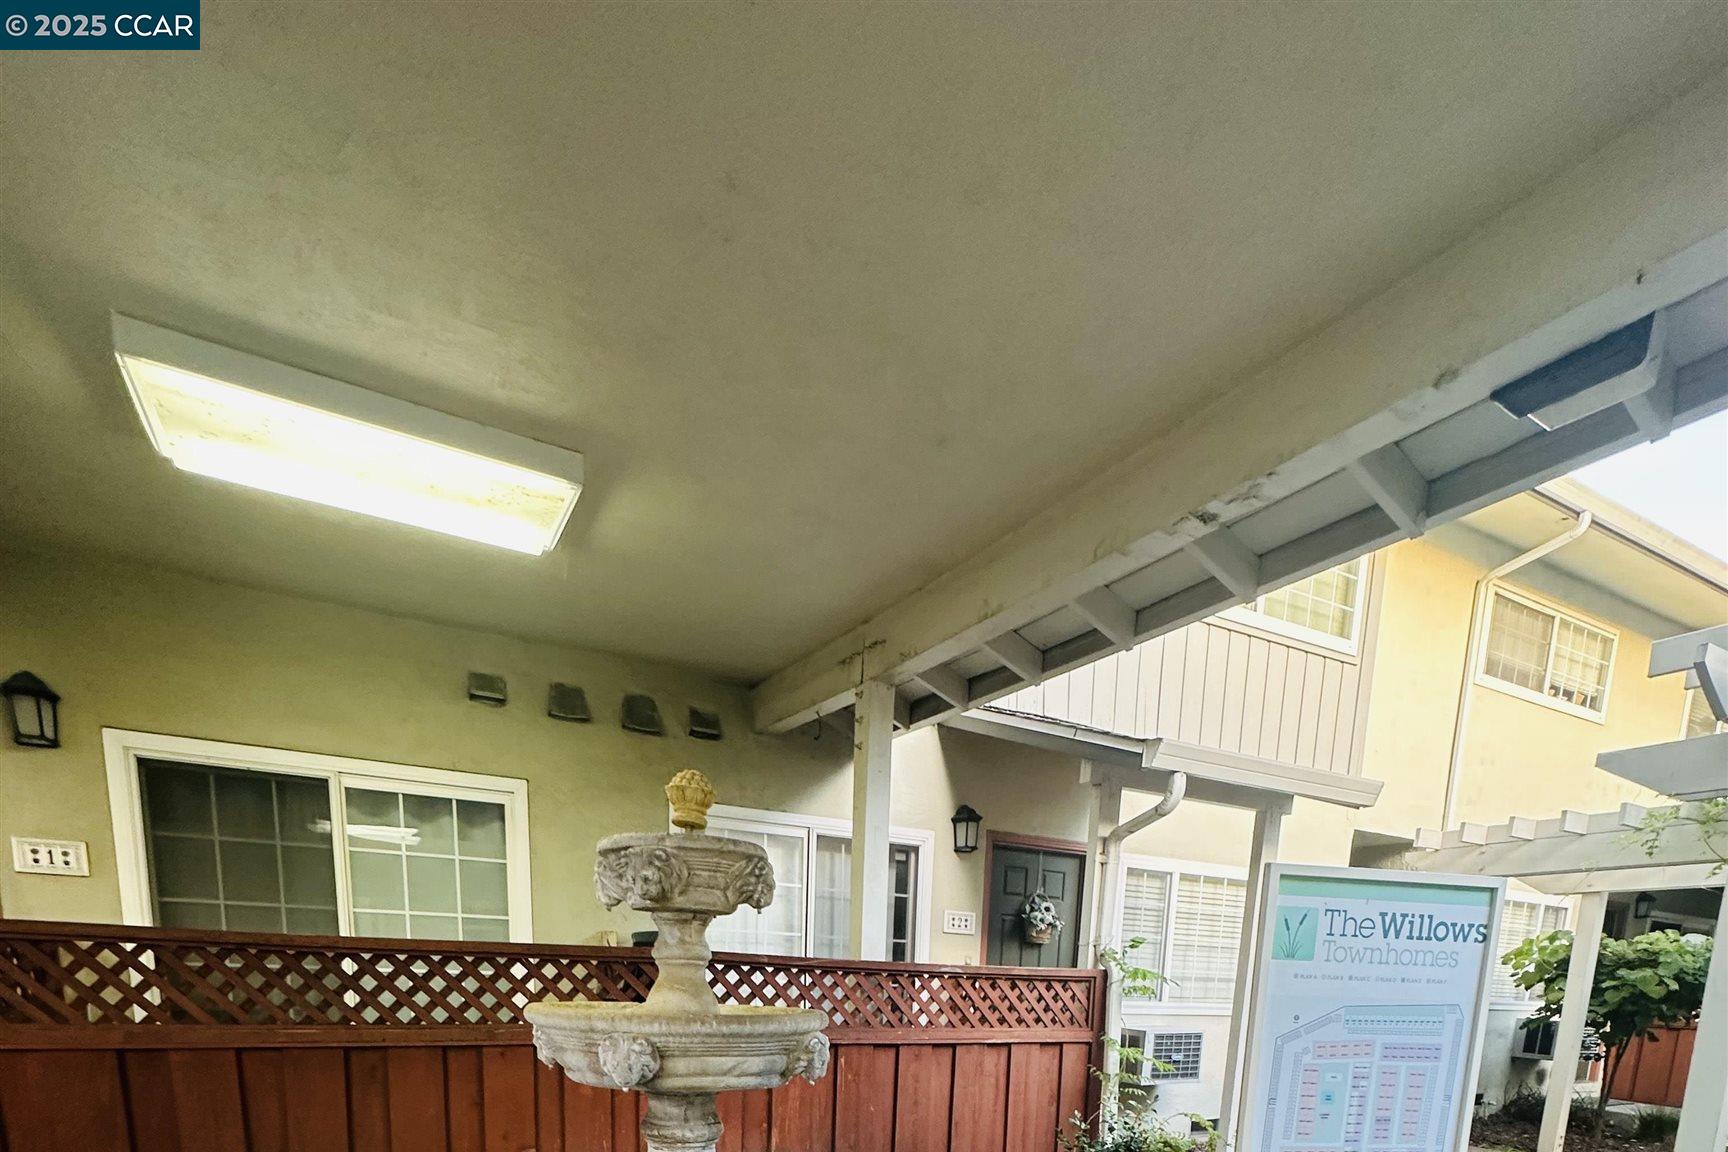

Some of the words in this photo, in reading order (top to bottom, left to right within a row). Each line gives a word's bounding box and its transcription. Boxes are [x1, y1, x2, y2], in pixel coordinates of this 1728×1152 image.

[47, 849, 55, 865] 1
[1324, 908, 1376, 939] The
[1379, 911, 1488, 944] Willows
[1322, 940, 1459, 968] Townhomes
